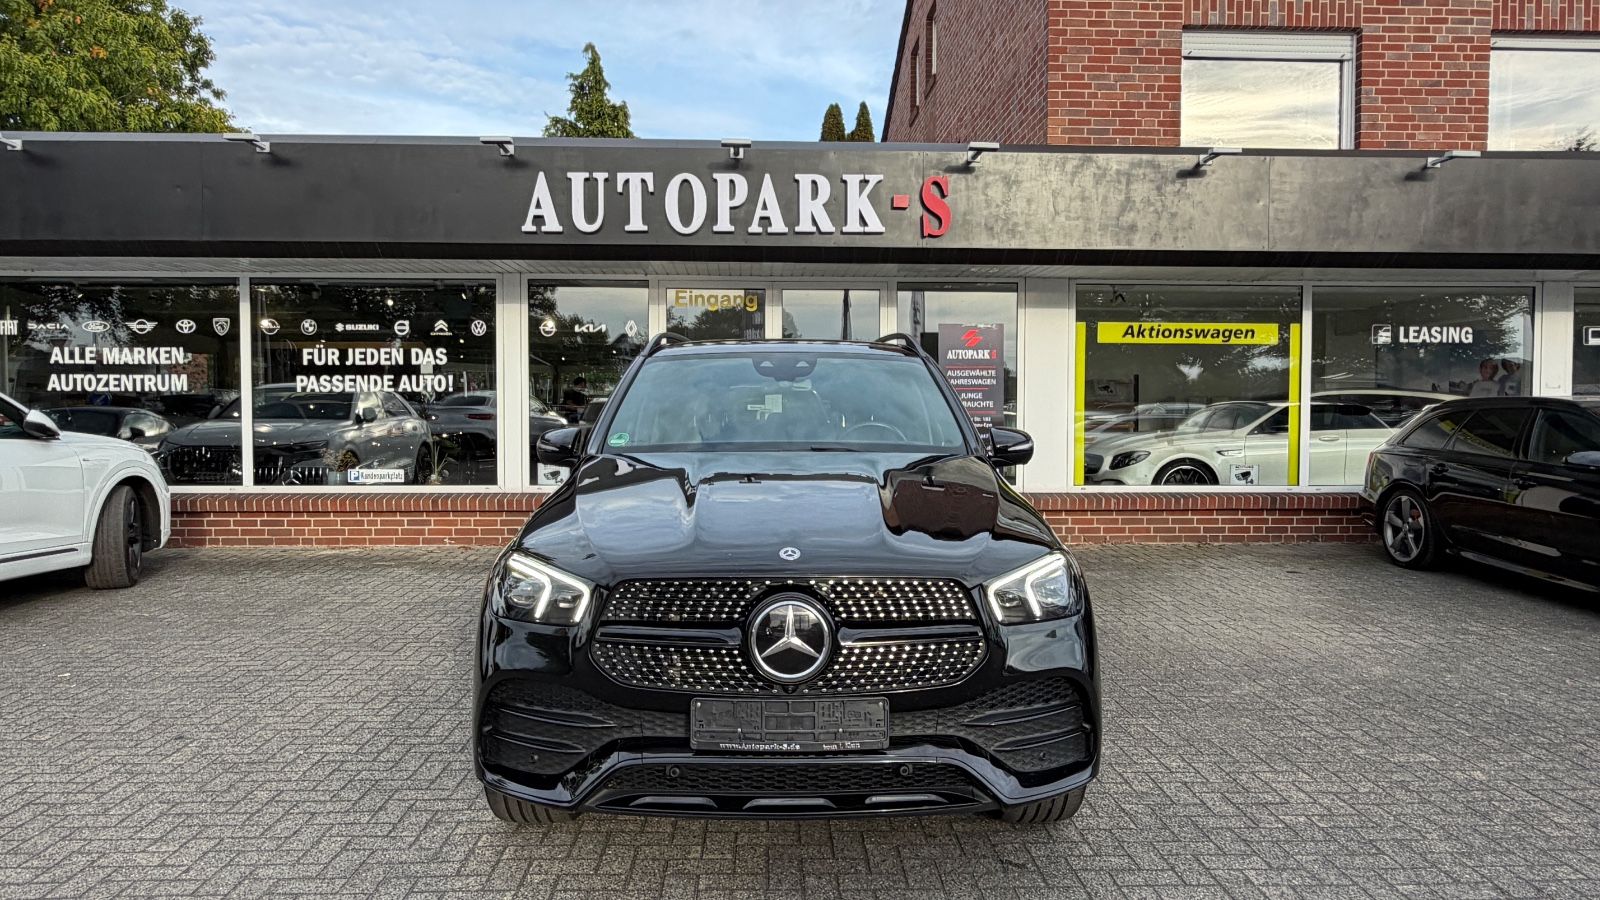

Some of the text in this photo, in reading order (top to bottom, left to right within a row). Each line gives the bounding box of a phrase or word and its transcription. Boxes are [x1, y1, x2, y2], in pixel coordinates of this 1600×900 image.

[521, 171, 952, 237] AUTOPARK-S
[674, 290, 758, 312] Eingang
[0, 320, 18, 335] FIAT
[1122, 324, 1256, 343] Aktionswagen
[1399, 326, 1473, 344] LEASING
[50, 347, 97, 365] ALLE
[302, 344, 448, 366] FÜR JEDEN DAS
[47, 374, 188, 391] AUTOZENTRUM
[296, 375, 454, 392] PASSENDE AUTO!
